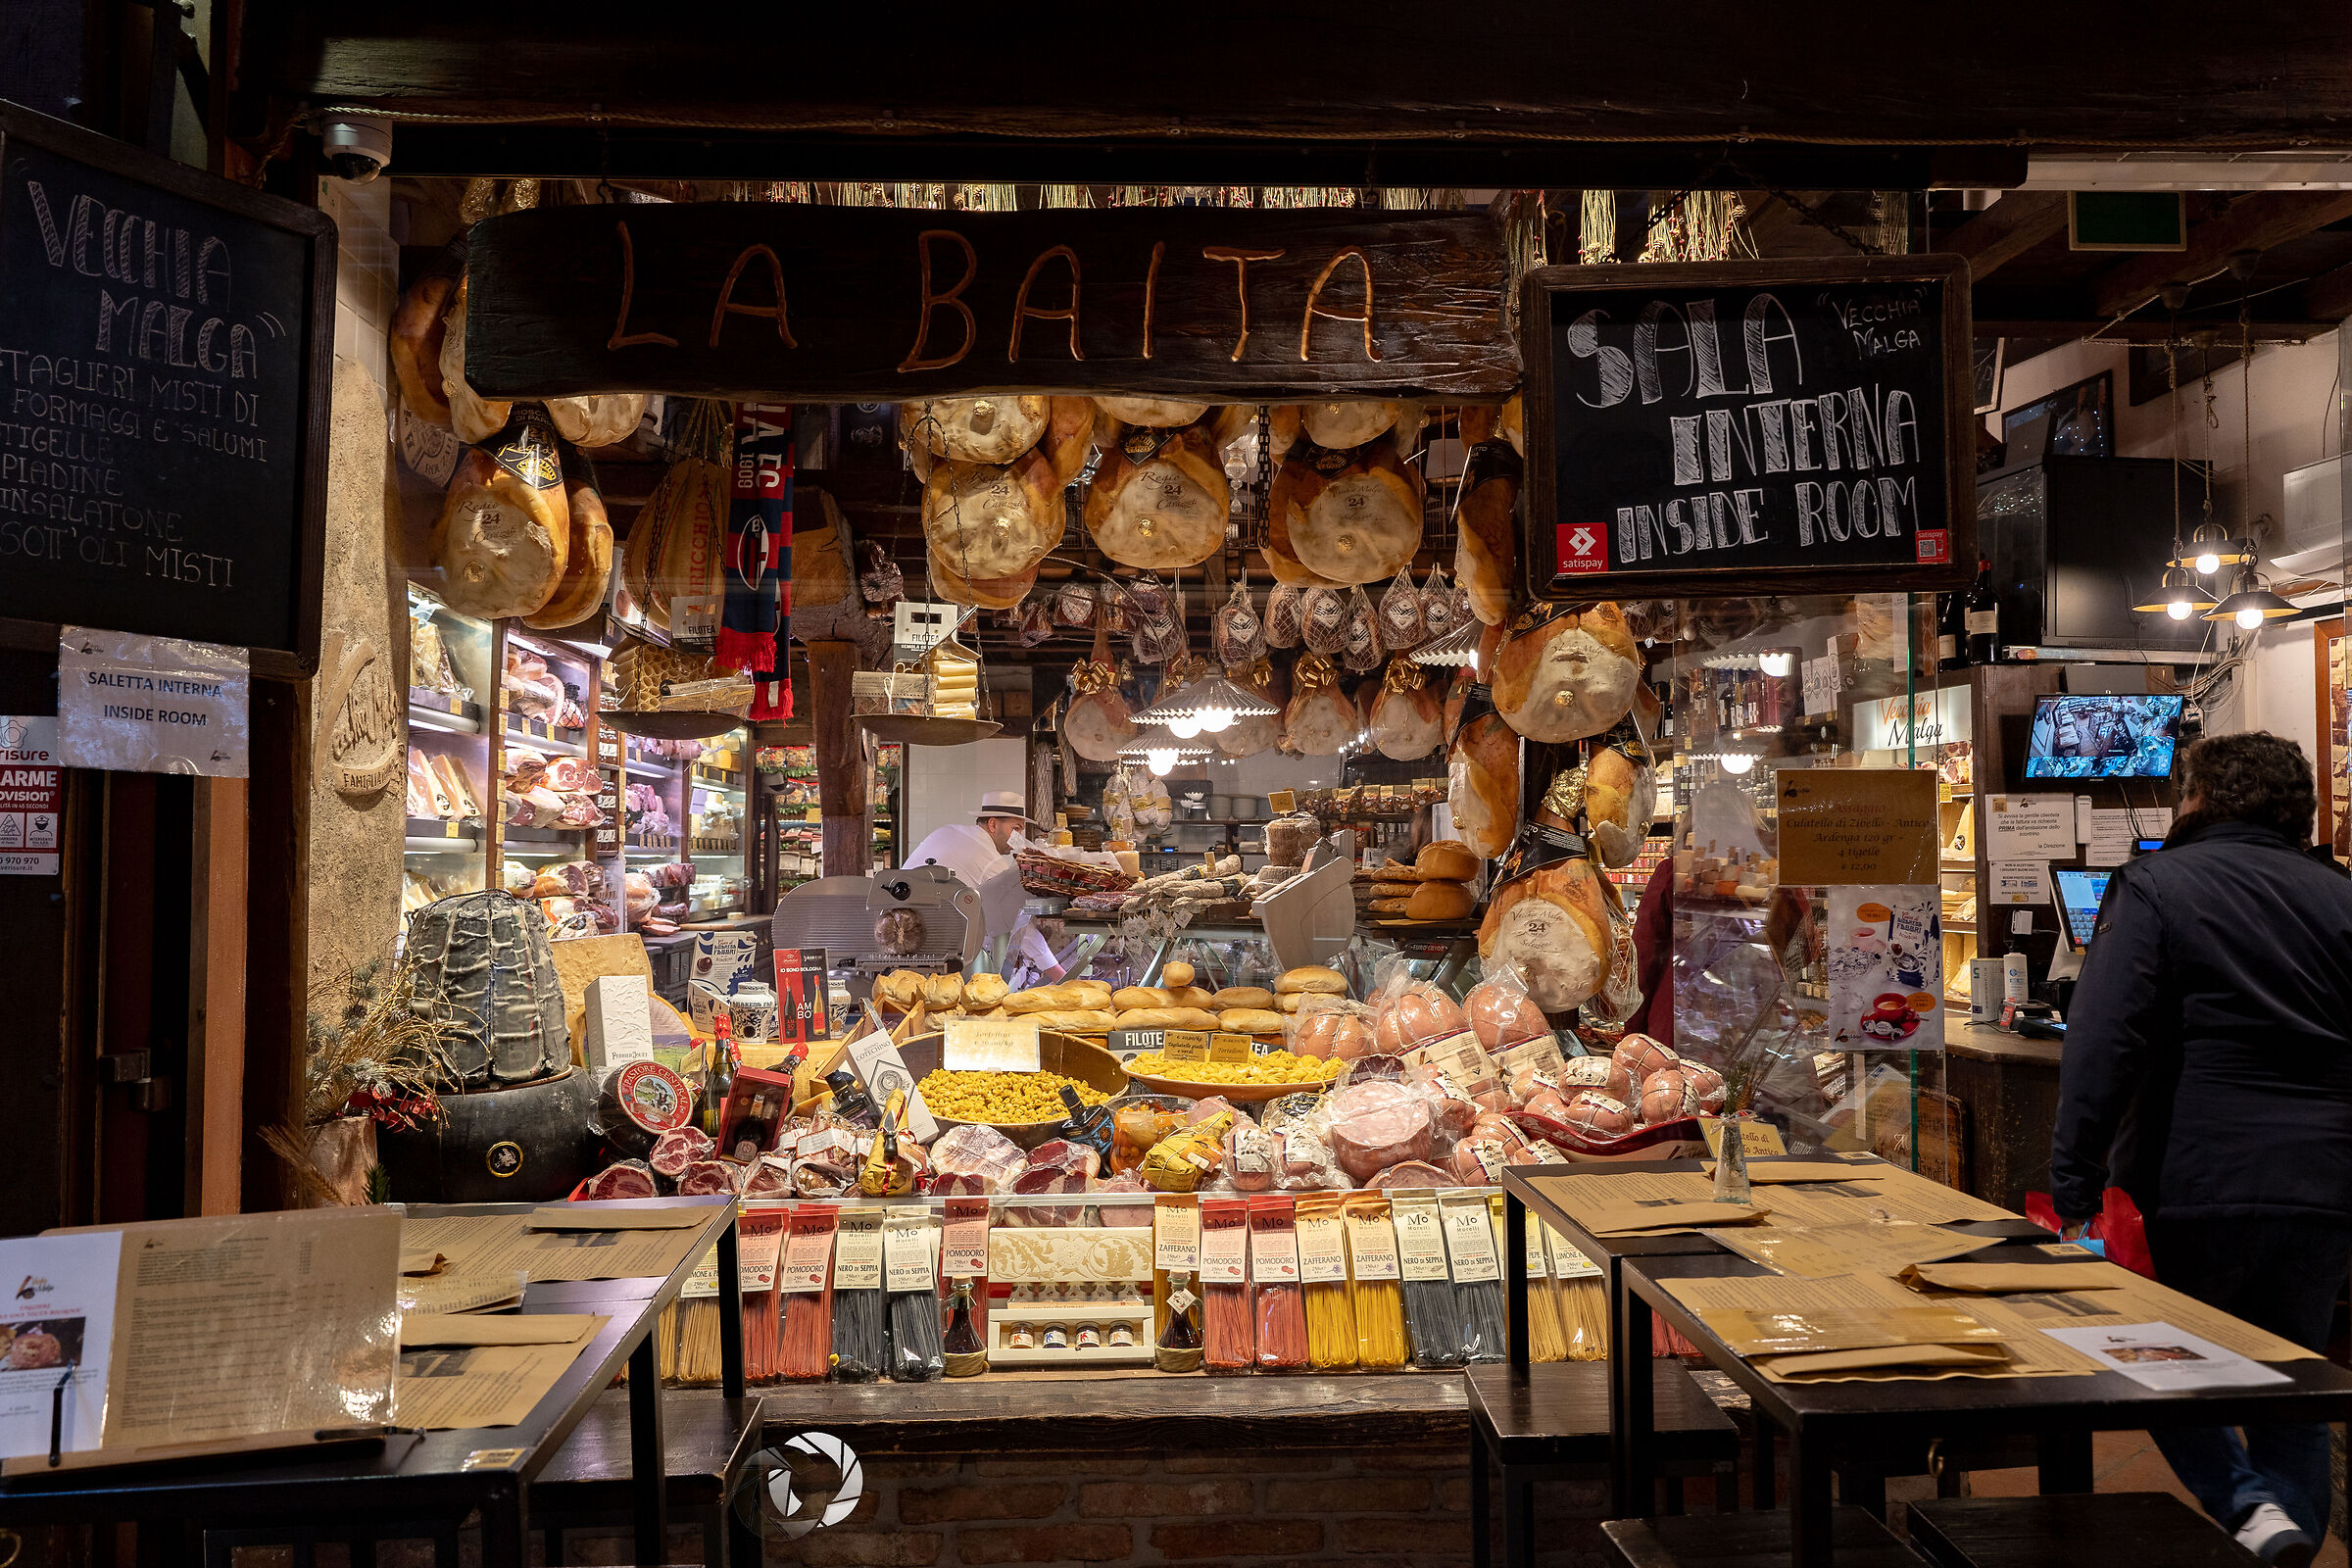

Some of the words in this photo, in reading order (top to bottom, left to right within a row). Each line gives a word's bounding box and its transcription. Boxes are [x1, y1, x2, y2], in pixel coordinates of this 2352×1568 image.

[609, 220, 798, 350] LA
[898, 227, 1383, 372] BAITA
[1567, 294, 1803, 408] SALA
[149, 375, 221, 417] MISTI
[235, 391, 259, 427] DI
[13, 388, 141, 439] FORMAGGI
[153, 419, 169, 442] E
[182, 423, 267, 462] SALUMI
[1671, 383, 1919, 485] INTERNA
[0, 422, 114, 465] TIGELLE
[2, 453, 122, 496] PIADINE
[737, 453, 755, 488] 1909
[755, 454, 783, 487] FC
[991, 484, 1009, 495] 24
[1163, 484, 1182, 496] 24
[1348, 495, 1365, 507] 24
[0, 488, 182, 542] INSALATONE
[482, 513, 502, 525] 24
[1617, 488, 1768, 563] INSIDE
[1795, 476, 1919, 546] ROOM
[146, 546, 232, 588] MISTI
[1563, 558, 1603, 569] satispay
[689, 625, 716, 635] FILOTEA
[912, 633, 940, 643] FILOTEA
[88, 671, 154, 691] SALETTA
[158, 679, 222, 698] INTERNA
[104, 705, 154, 721] INSIDE
[158, 710, 207, 726] ROOM
[1887, 717, 1943, 747] Malga
[6, 855, 21, 864] 970
[24, 855, 39, 864] 970
[1510, 906, 1538, 920] Vecchia
[1541, 910, 1564, 921] Malga
[1528, 922, 1545, 932] 24
[1897, 923, 1922, 934] FABBRI
[797, 1002, 812, 1010] AM
[1125, 1032, 1163, 1047] FILOTE
[856, 1041, 890, 1061] COTECHINO
[625, 1064, 657, 1088] PASTORE
[1760, 1133, 1769, 1143] di
[1752, 1146, 1779, 1155] Antico
[956, 1206, 978, 1217] Mo
[1166, 1204, 1188, 1213] Mo
[1214, 1218, 1236, 1229] Mo
[1261, 1217, 1284, 1229] Mo
[1307, 1217, 1329, 1228] Mo
[1358, 1214, 1380, 1225] Mo
[1407, 1214, 1429, 1225] Mo
[1456, 1215, 1478, 1226] Mo
[750, 1224, 772, 1236] Mo
[803, 1224, 825, 1236] Mo
[851, 1221, 872, 1233] Mo
[896, 1228, 918, 1239] Mo
[946, 1249, 985, 1257] POMODORO
[1158, 1244, 1197, 1253] ZAFFERANO
[1303, 1255, 1341, 1265] ZAFFERANO
[1356, 1254, 1395, 1263] ZAFFERANO
[1556, 1250, 1577, 1259] LIMONE
[1476, 1256, 1494, 1265] SEPPIA
[740, 1265, 773, 1274] OMODORO
[787, 1264, 824, 1274] POMODORO
